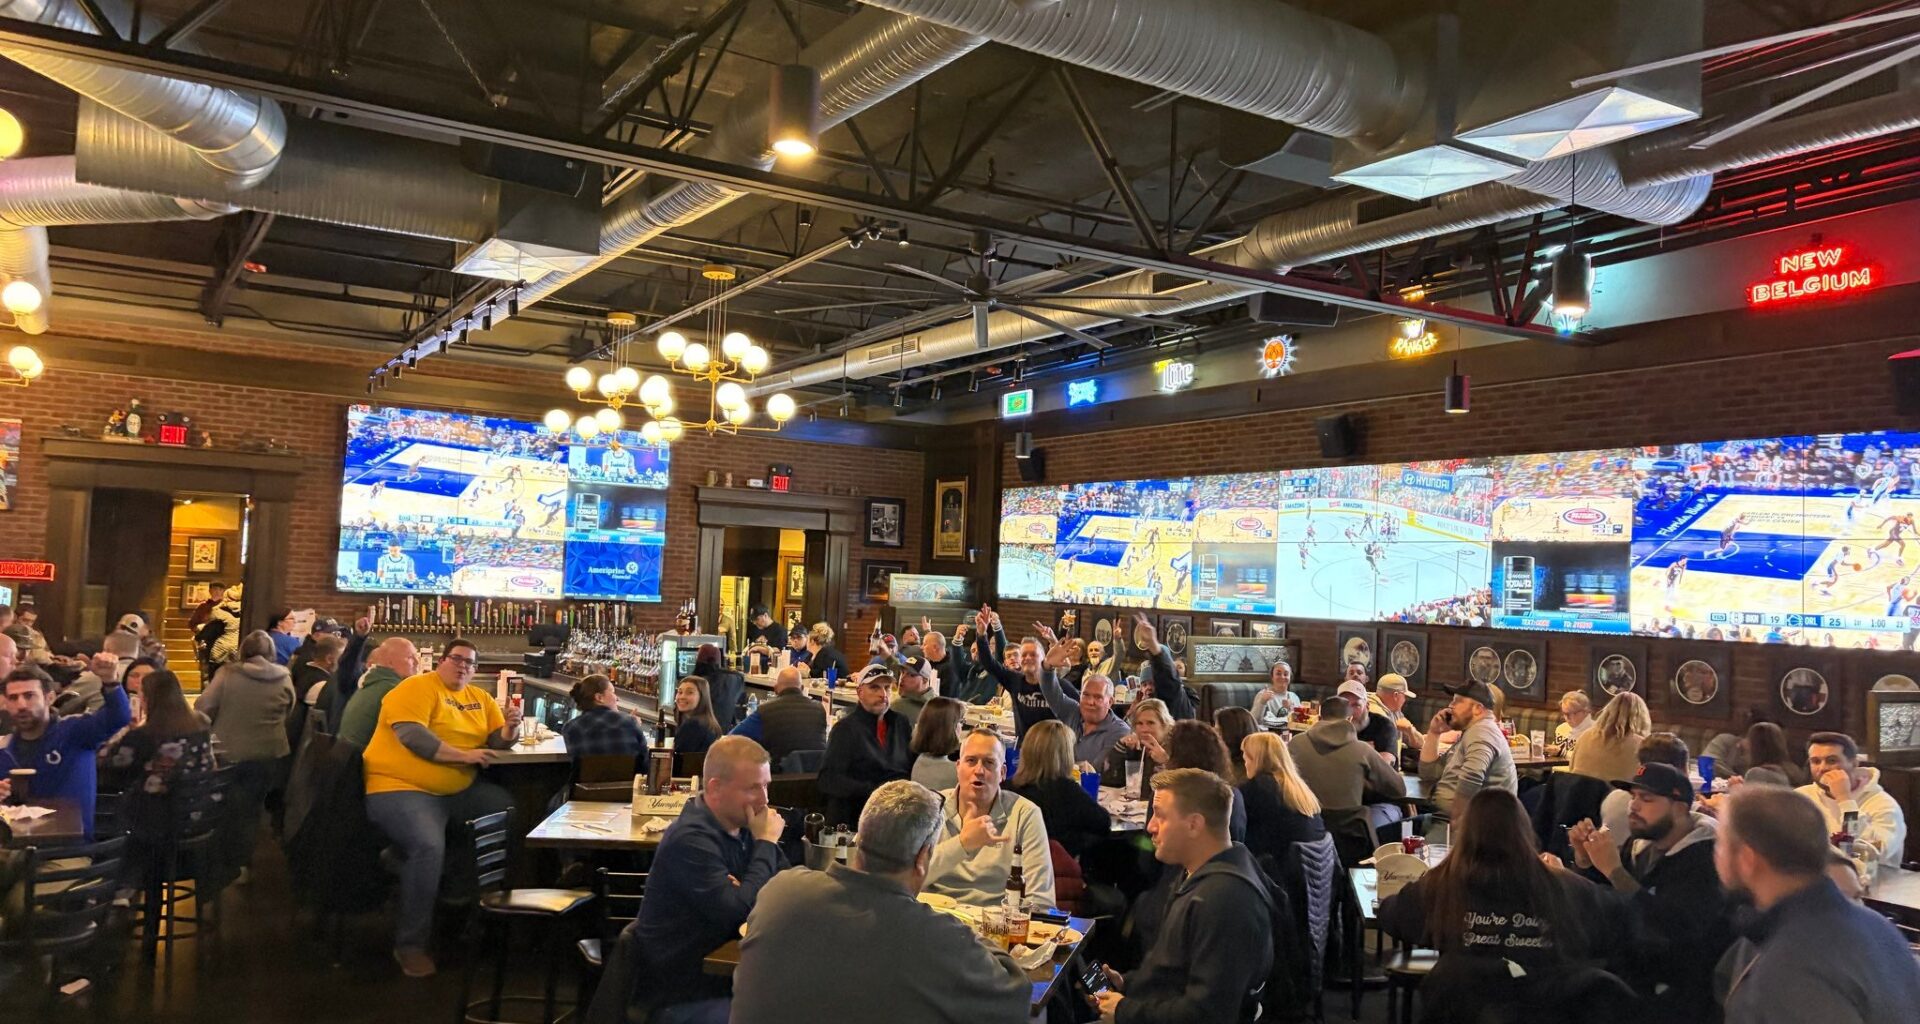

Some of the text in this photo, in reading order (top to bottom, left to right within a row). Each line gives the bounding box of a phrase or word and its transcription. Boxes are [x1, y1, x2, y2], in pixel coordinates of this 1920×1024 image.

[1780, 247, 1842, 274] NEW
[1752, 267, 1871, 303] BELGIUM
[1394, 332, 1438, 355] RANGER
[1163, 361, 1195, 392] Lite
[161, 425, 187, 444] EXIT
[773, 475, 789, 490] EXIT
[1415, 475, 1450, 491] HYUNDAI
[1656, 514, 1693, 536] Florida
[587, 565, 626, 575] Ameriprise
[1770, 615, 1781, 624] 19
[1804, 616, 1818, 626] ORL
[1829, 618, 1841, 627] 25
[1464, 912, 1508, 929] You're
[1463, 932, 1501, 947] Great
